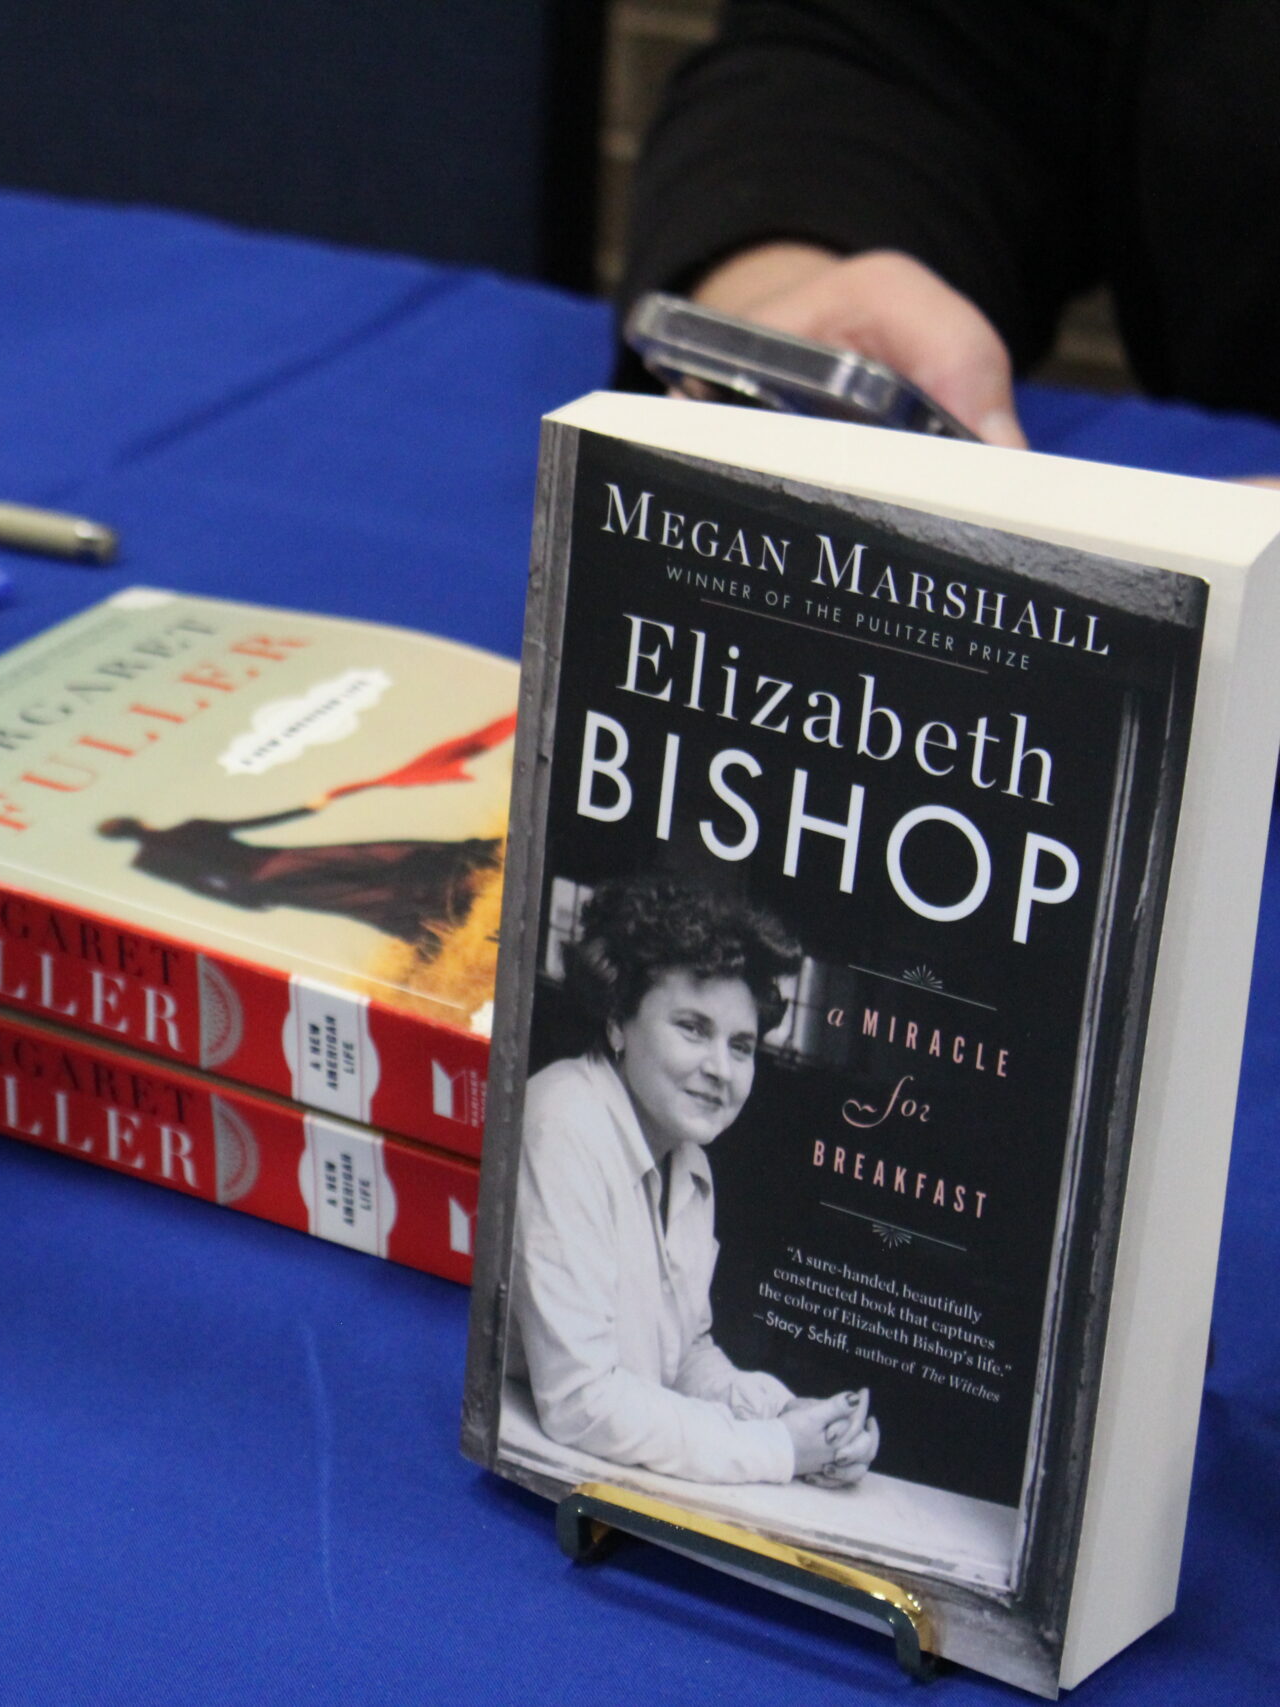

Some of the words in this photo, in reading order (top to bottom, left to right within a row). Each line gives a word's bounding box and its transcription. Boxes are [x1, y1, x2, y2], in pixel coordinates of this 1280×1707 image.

[601, 482, 791, 576] MEGAN
[811, 534, 1110, 656] MARSHALL
[665, 564, 753, 601] WINNER
[764, 590, 793, 609] OF
[804, 598, 843, 623] THE
[855, 612, 957, 652] PULITZER
[969, 640, 1031, 671] PRIZE
[615, 613, 1055, 807] Elizabeth
[577, 709, 1080, 945] BISHOP
[308, 1023, 322, 1056] NEW
[323, 1015, 339, 1091] AMERICAN
[342, 1041, 355, 1076] LIFE
[827, 1007, 845, 1027] a
[862, 1008, 1010, 1078] MIRACLE
[842, 1074, 931, 1128] for
[325, 1160, 337, 1191] NEW
[341, 1154, 355, 1227] AMERICAN
[358, 1177, 371, 1213] LIFE
[814, 1139, 987, 1219] BREAKFAST
[759, 1282, 781, 1302] the
[784, 1294, 821, 1315] color
[823, 1306, 840, 1321] of
[841, 1309, 909, 1345] Elizabeth
[912, 1333, 974, 1366] Bishop’s
[773, 1267, 858, 1305] constructed
[860, 1292, 896, 1318] book
[899, 1306, 929, 1329] that
[931, 1320, 996, 1351] captures
[805, 1256, 898, 1297] sure-handed,
[902, 1283, 983, 1325] beautifully
[855, 1345, 900, 1369] author
[900, 1361, 916, 1375] of
[921, 1364, 946, 1385] The
[949, 1373, 1001, 1402] Witches
